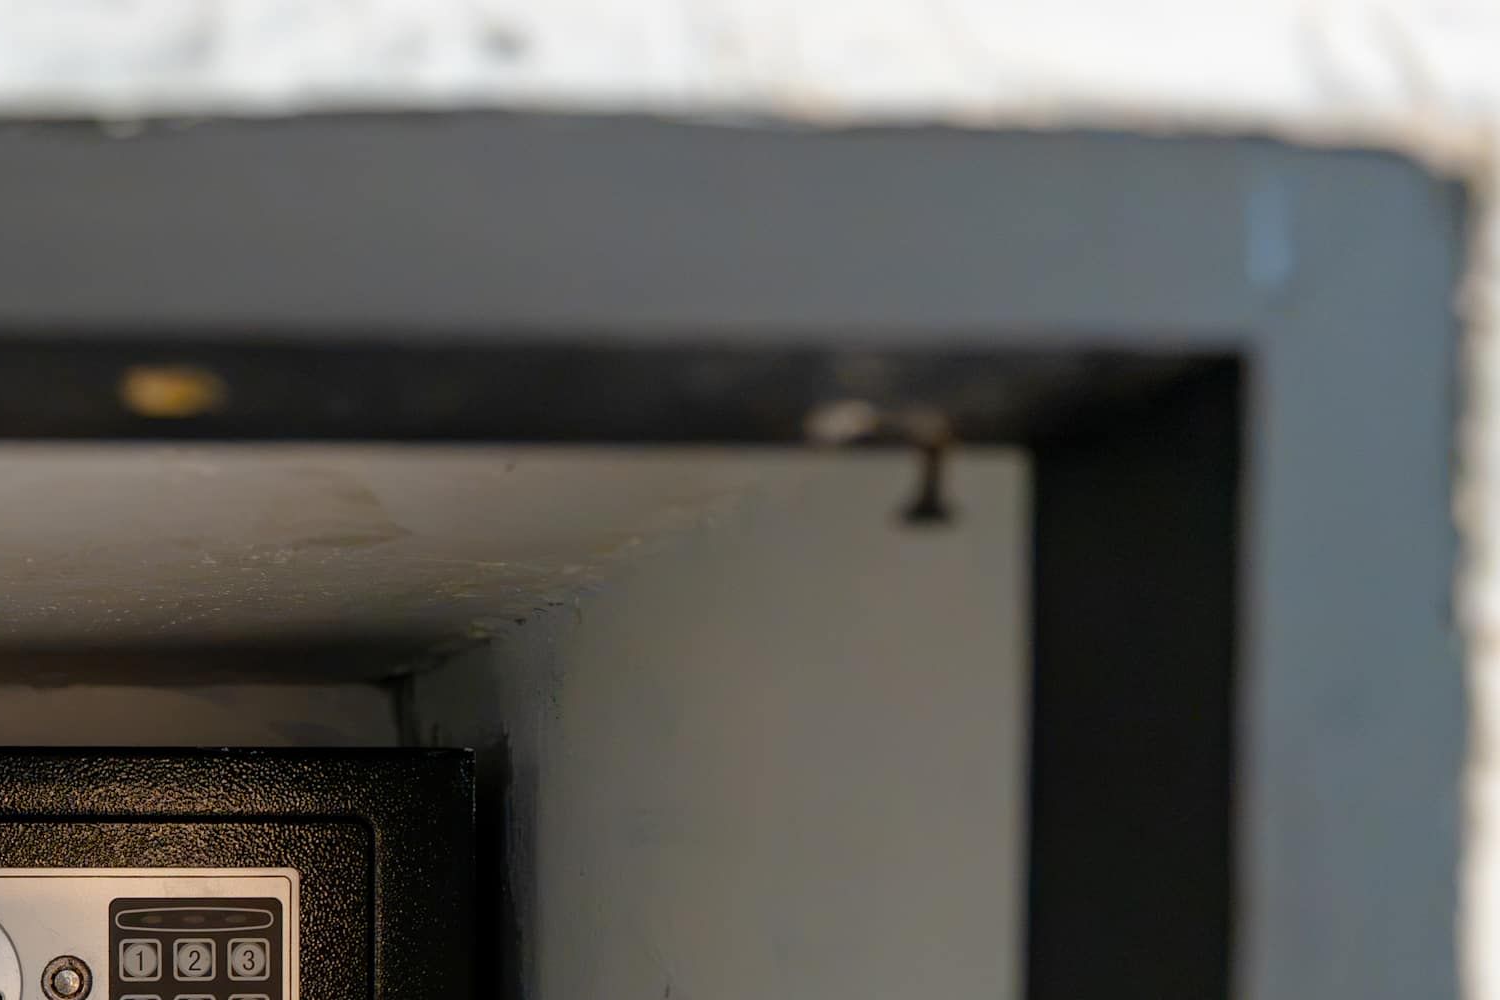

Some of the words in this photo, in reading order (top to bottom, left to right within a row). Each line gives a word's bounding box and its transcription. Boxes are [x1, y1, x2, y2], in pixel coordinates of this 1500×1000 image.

[136, 950, 143, 972] 1
[188, 950, 202, 971] 2
[242, 949, 255, 971] 3
